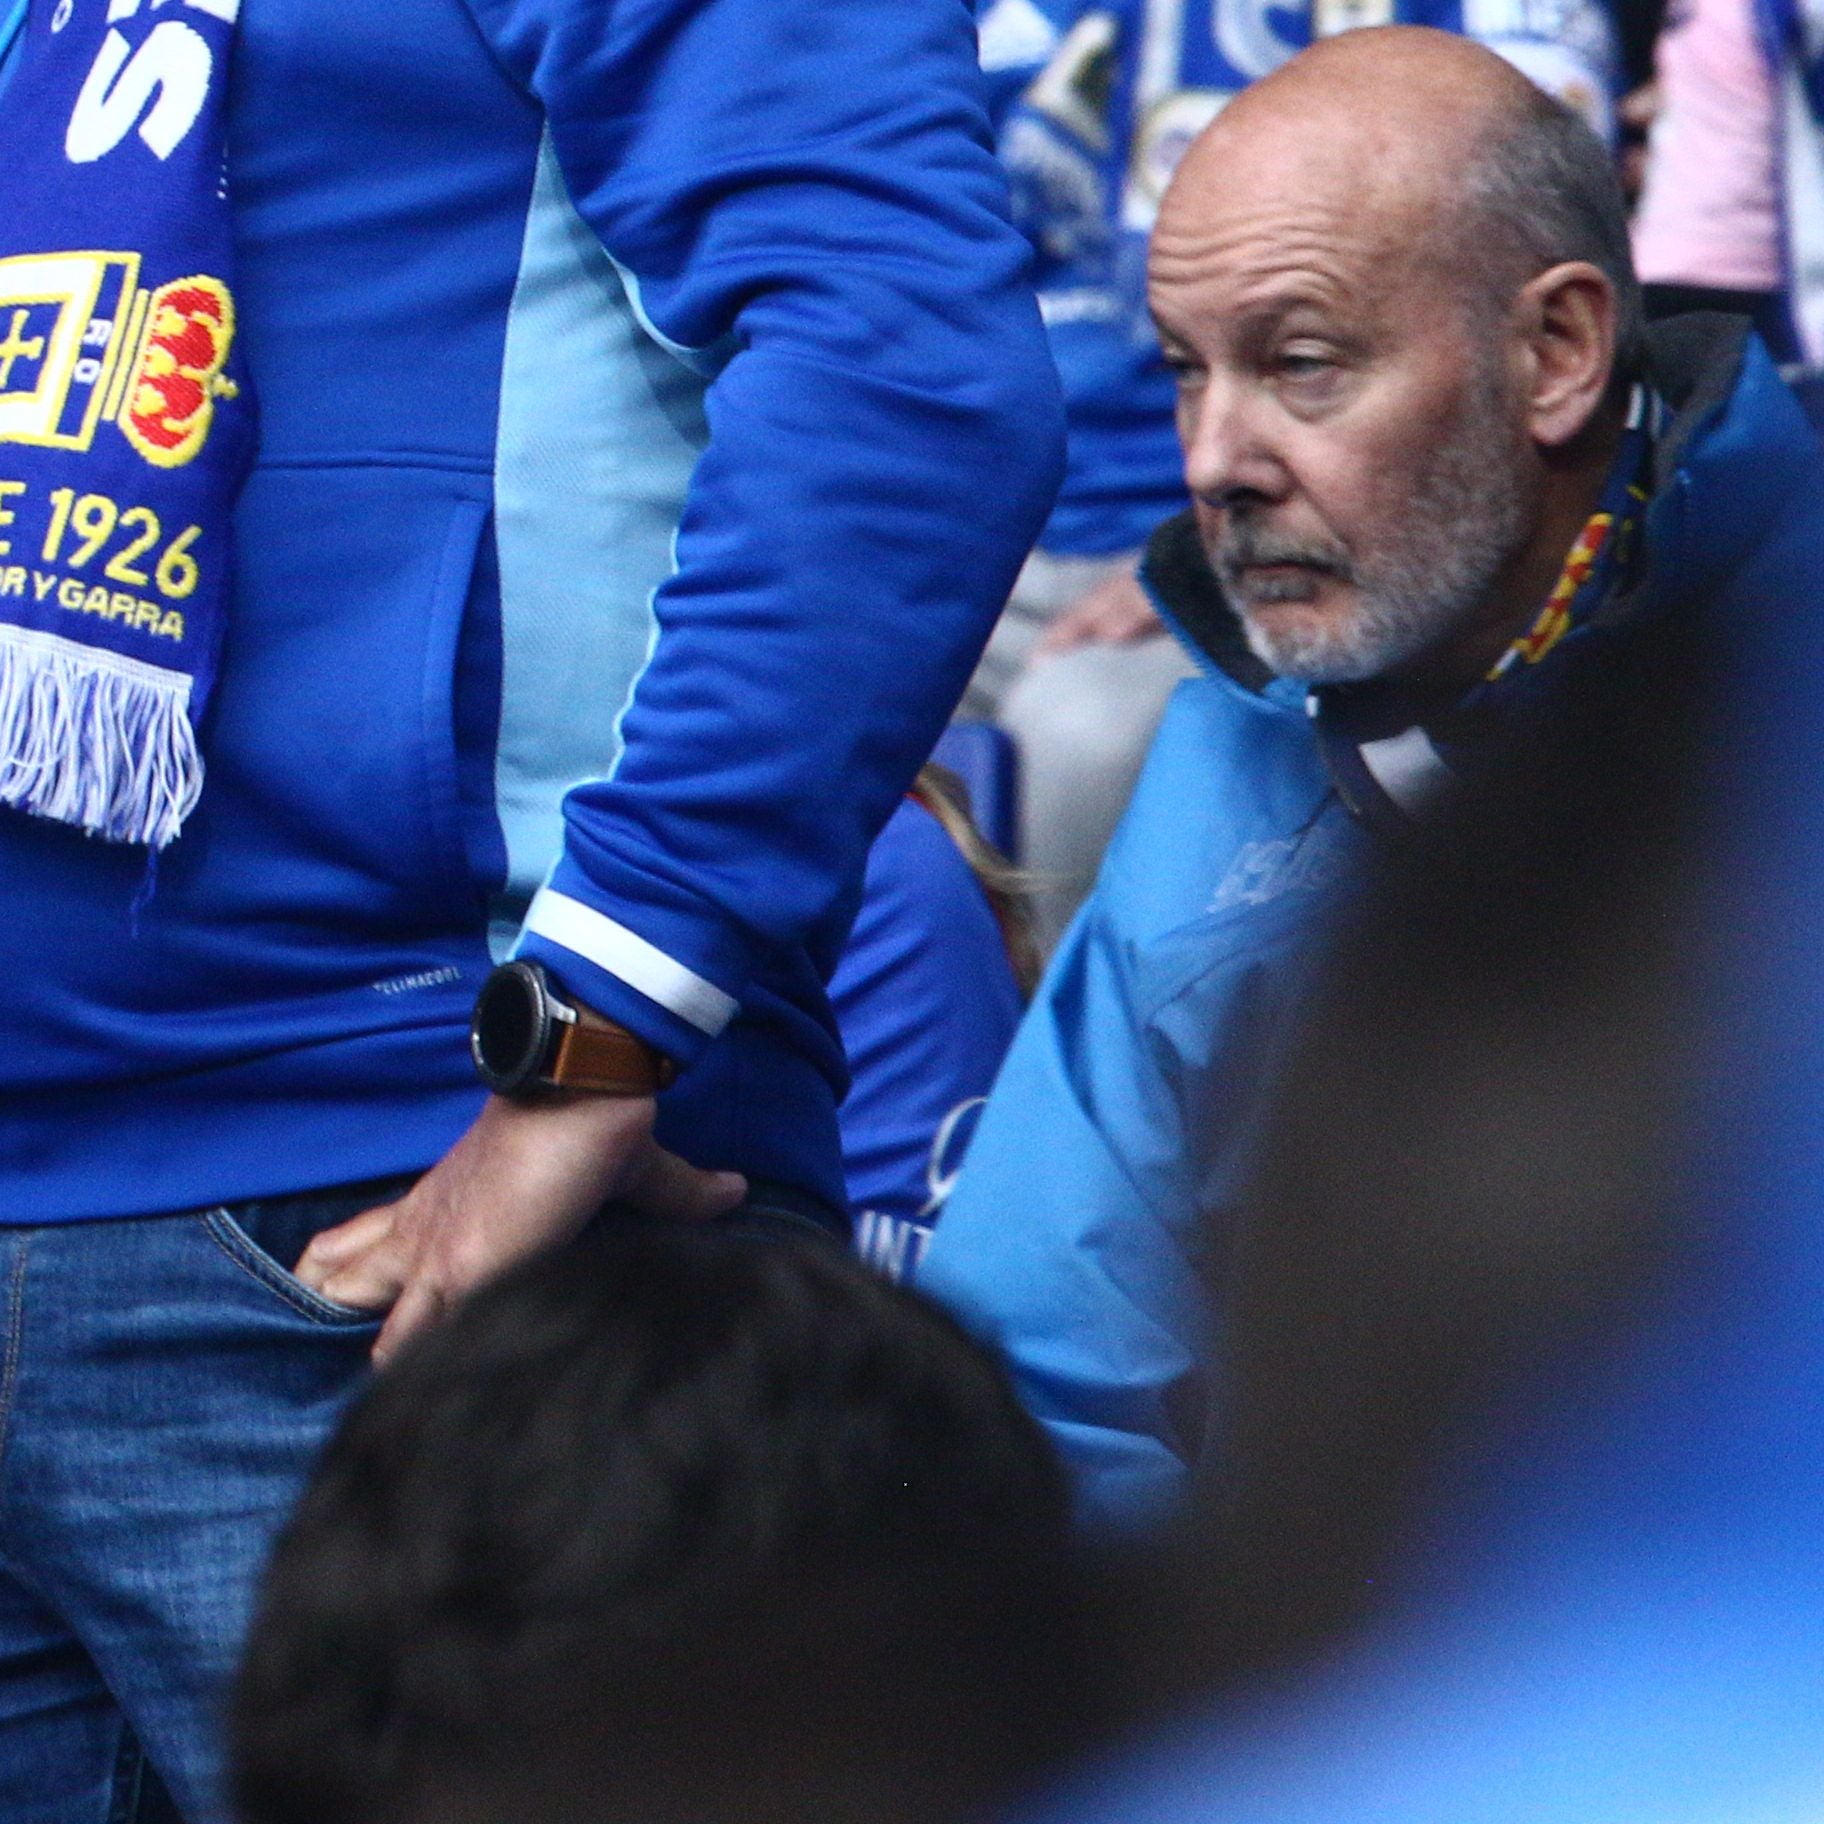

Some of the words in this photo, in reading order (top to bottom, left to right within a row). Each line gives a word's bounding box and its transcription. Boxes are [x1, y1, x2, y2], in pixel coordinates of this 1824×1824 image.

[42, 487, 203, 598] 1926
[33, 571, 58, 601] Y
[58, 579, 185, 641] GARRA
